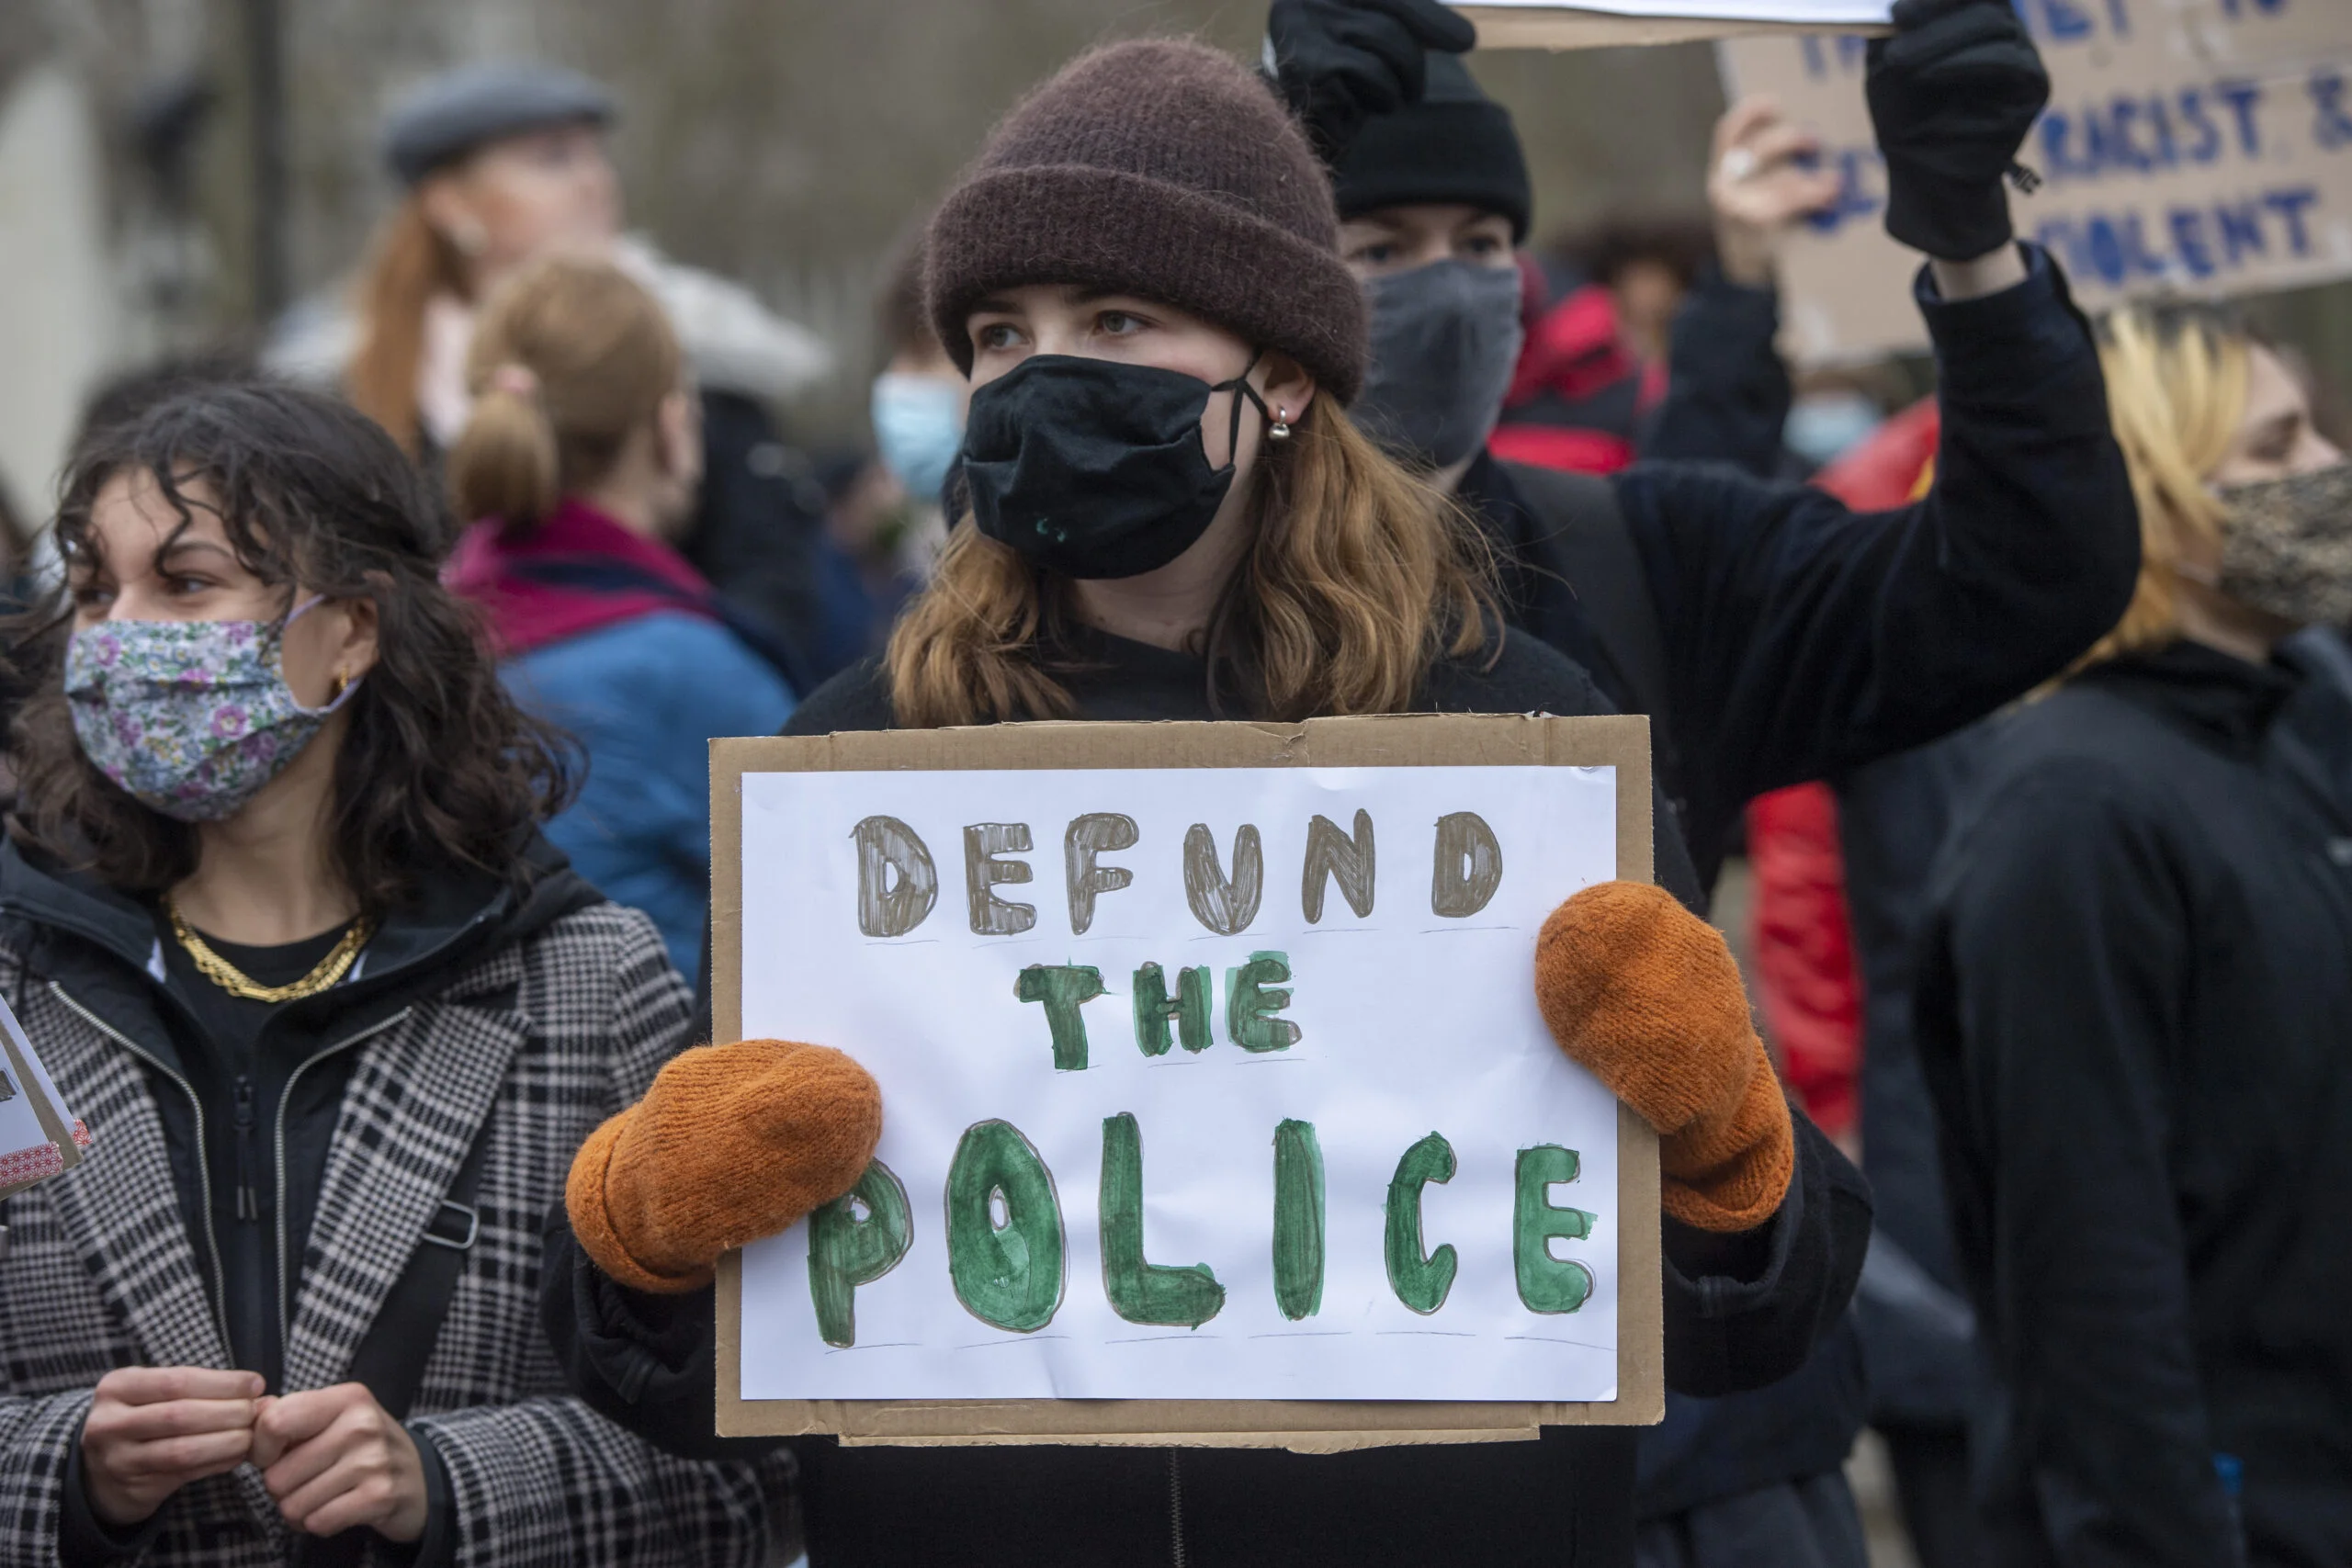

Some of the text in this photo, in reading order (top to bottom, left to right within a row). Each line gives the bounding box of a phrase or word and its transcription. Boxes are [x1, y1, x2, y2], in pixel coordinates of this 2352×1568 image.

[2036, 77, 2262, 187] RACIST
[851, 808, 1505, 937] DEFUND
[1012, 950, 1303, 1071] THE
[808, 1111, 1598, 1348] POLICE
